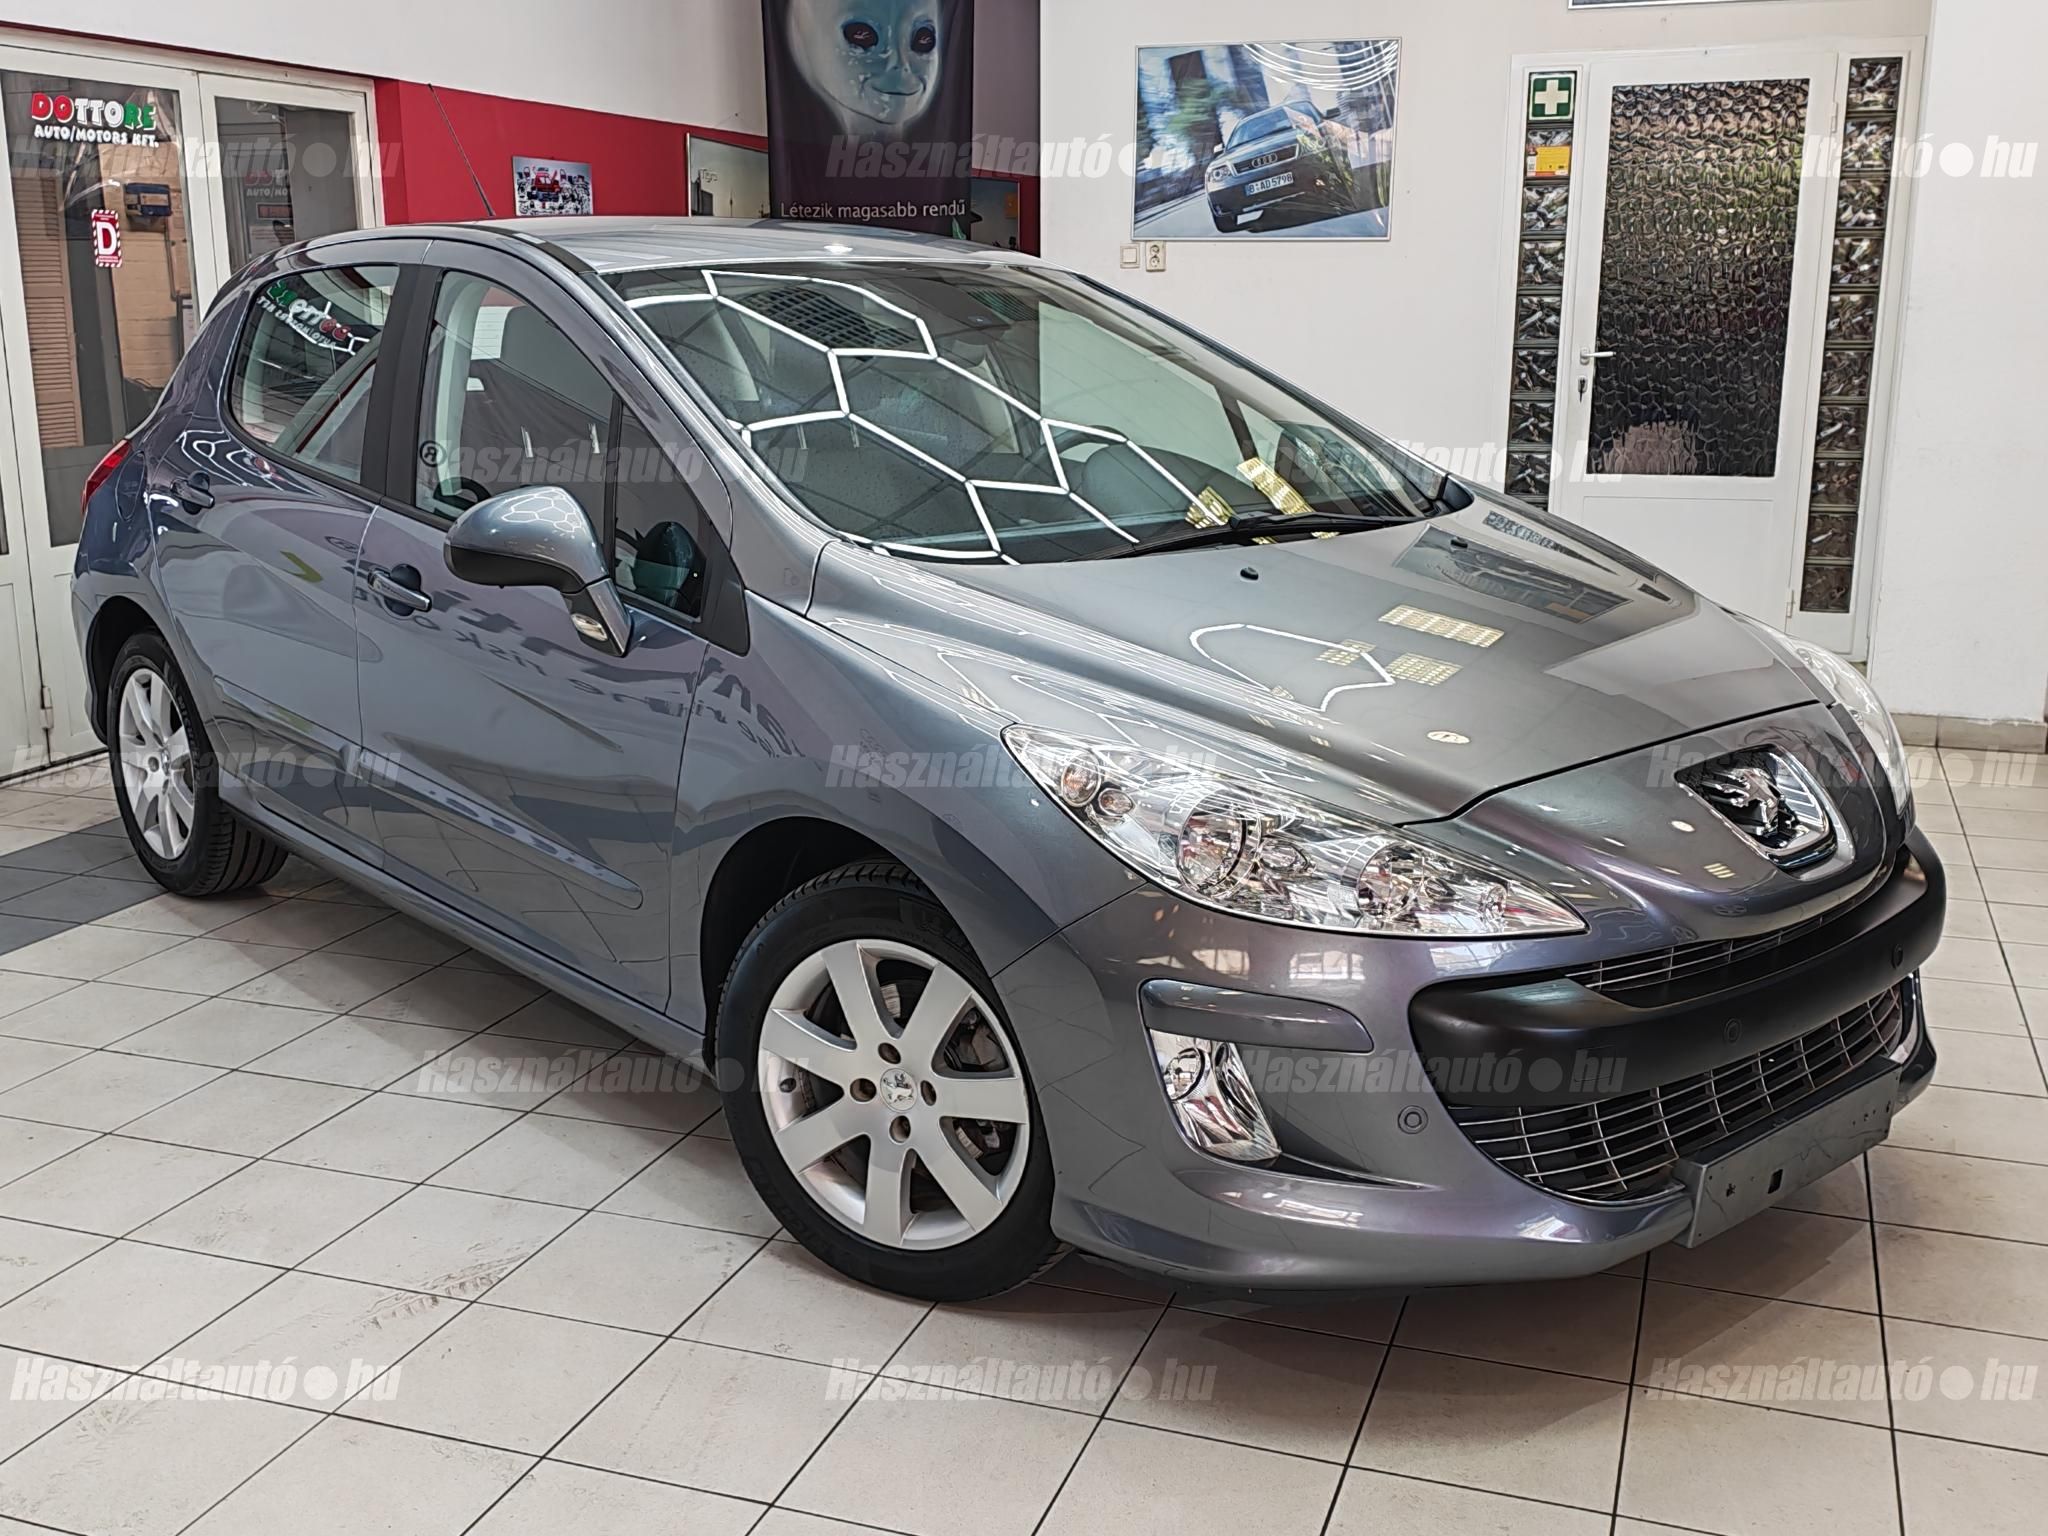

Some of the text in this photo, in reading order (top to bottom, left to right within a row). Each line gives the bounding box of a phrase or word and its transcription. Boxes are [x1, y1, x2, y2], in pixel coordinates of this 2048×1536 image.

[32, 92, 156, 130] DOTTORE
[781, 199, 965, 221] Létezik magasabb rendű
[96, 221, 117, 255] D
